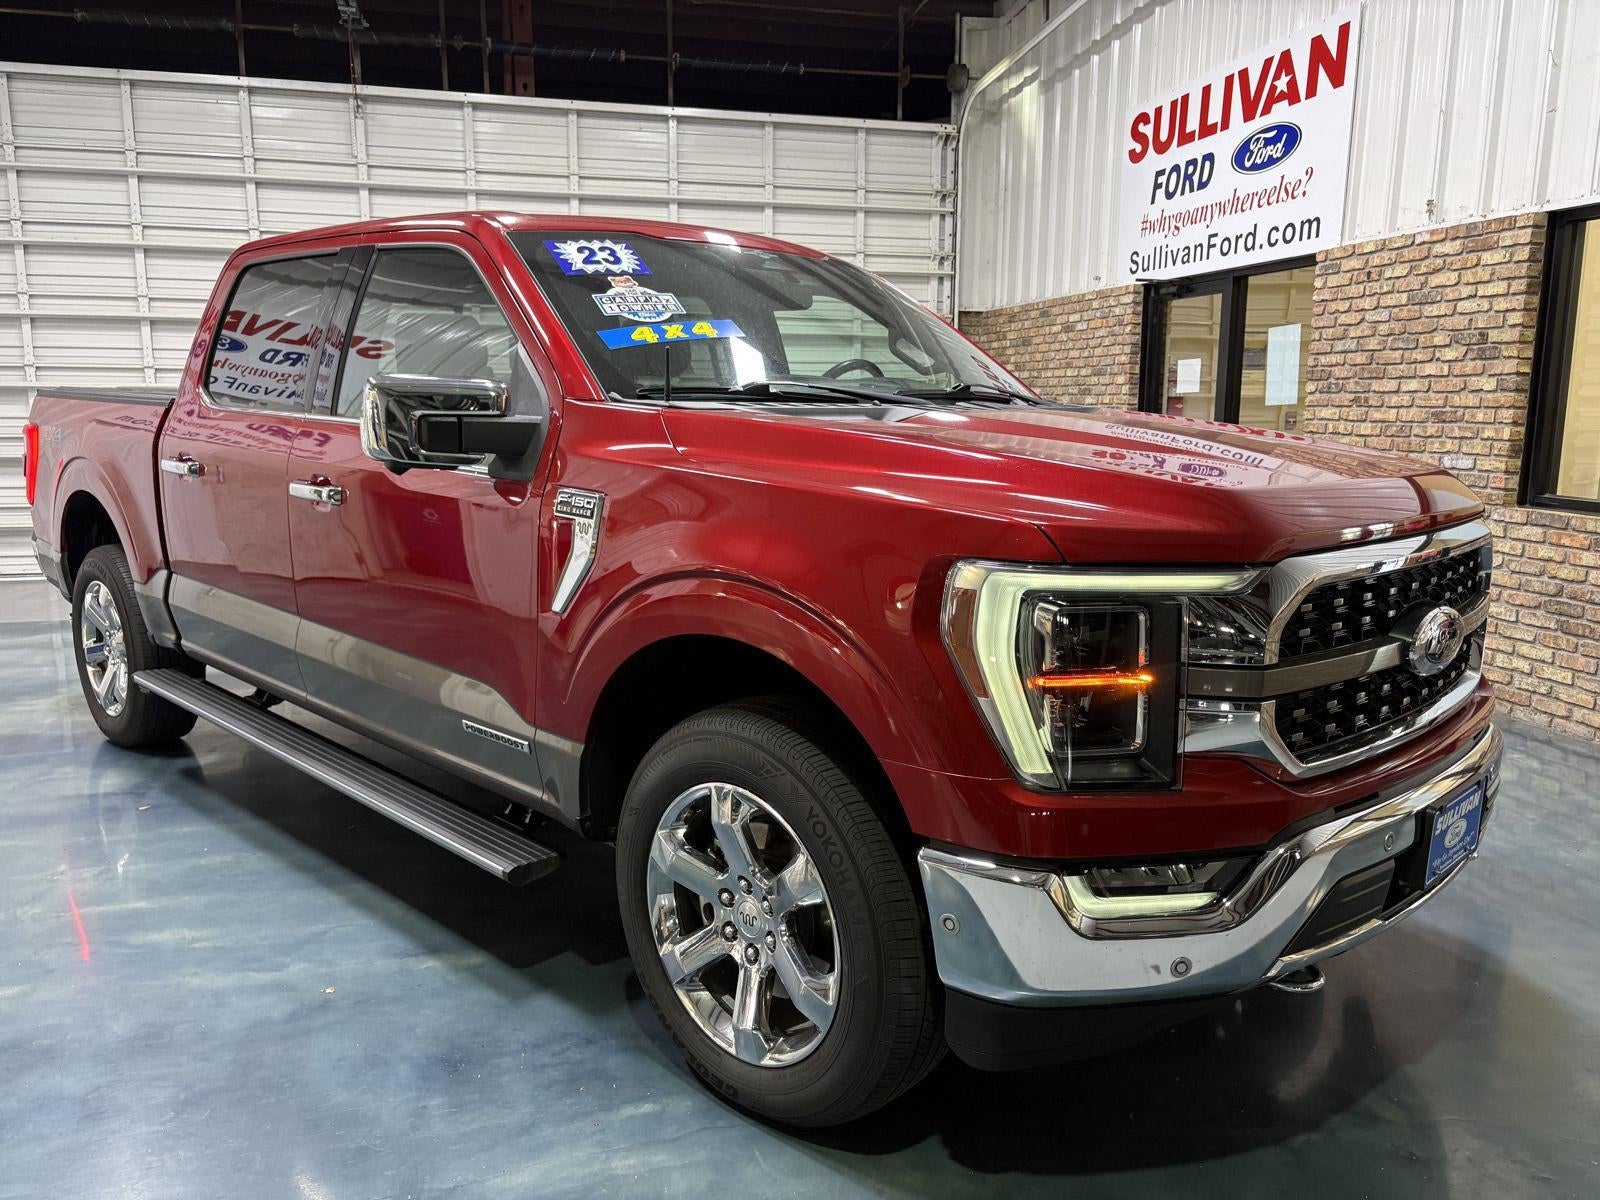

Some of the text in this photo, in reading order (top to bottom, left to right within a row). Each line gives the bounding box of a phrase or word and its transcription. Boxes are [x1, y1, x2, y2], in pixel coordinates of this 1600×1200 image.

[1128, 20, 1351, 164] SULLIVAN
[1244, 128, 1289, 168] Ford
[1140, 166, 1314, 239] #whygoanywhereelse?
[1150, 151, 1215, 205] FORD
[576, 244, 624, 266] 23
[1129, 215, 1322, 275] SullivanFord.com
[464, 722, 525, 750] POWERBOOST
[1434, 789, 1482, 836] SULLIVAN
